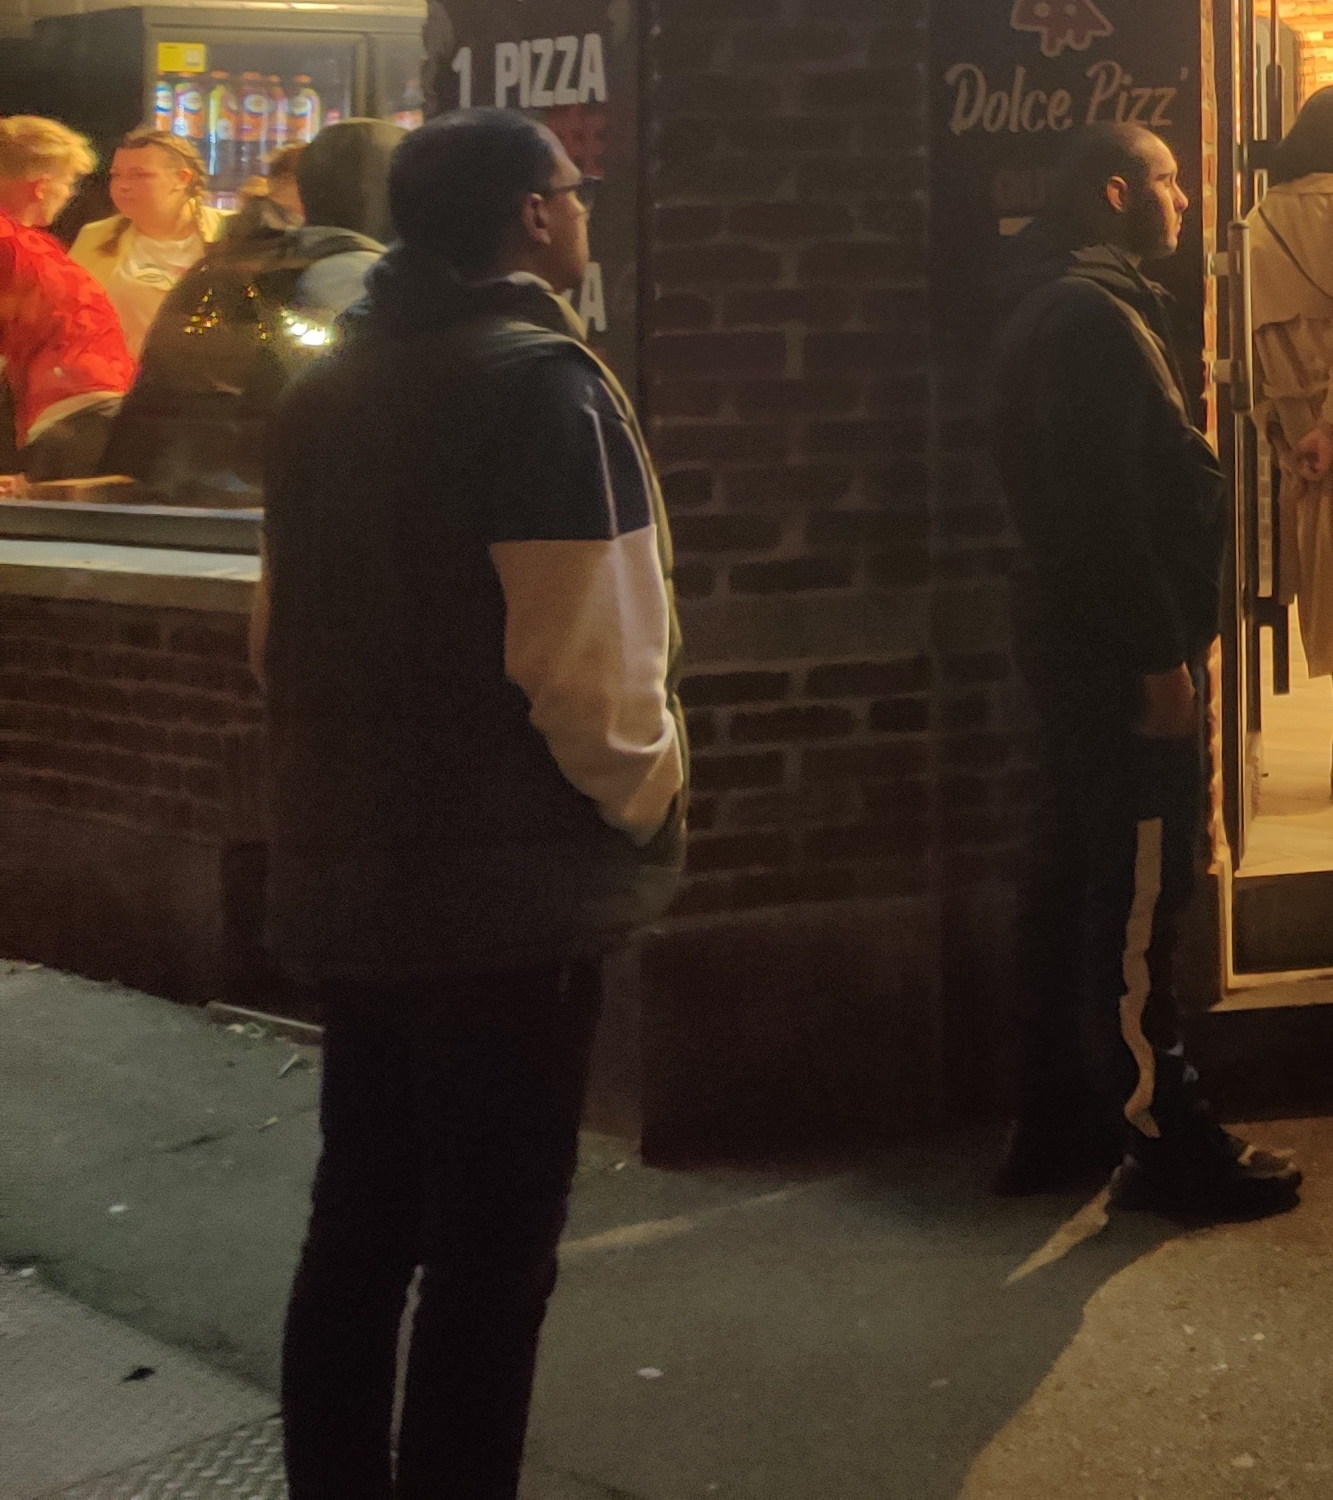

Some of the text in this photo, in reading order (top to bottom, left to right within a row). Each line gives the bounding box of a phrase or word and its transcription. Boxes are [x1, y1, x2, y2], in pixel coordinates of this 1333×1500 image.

[452, 33, 607, 109] 1 PIZZA
[945, 60, 1190, 136] Dolce Pizz'
